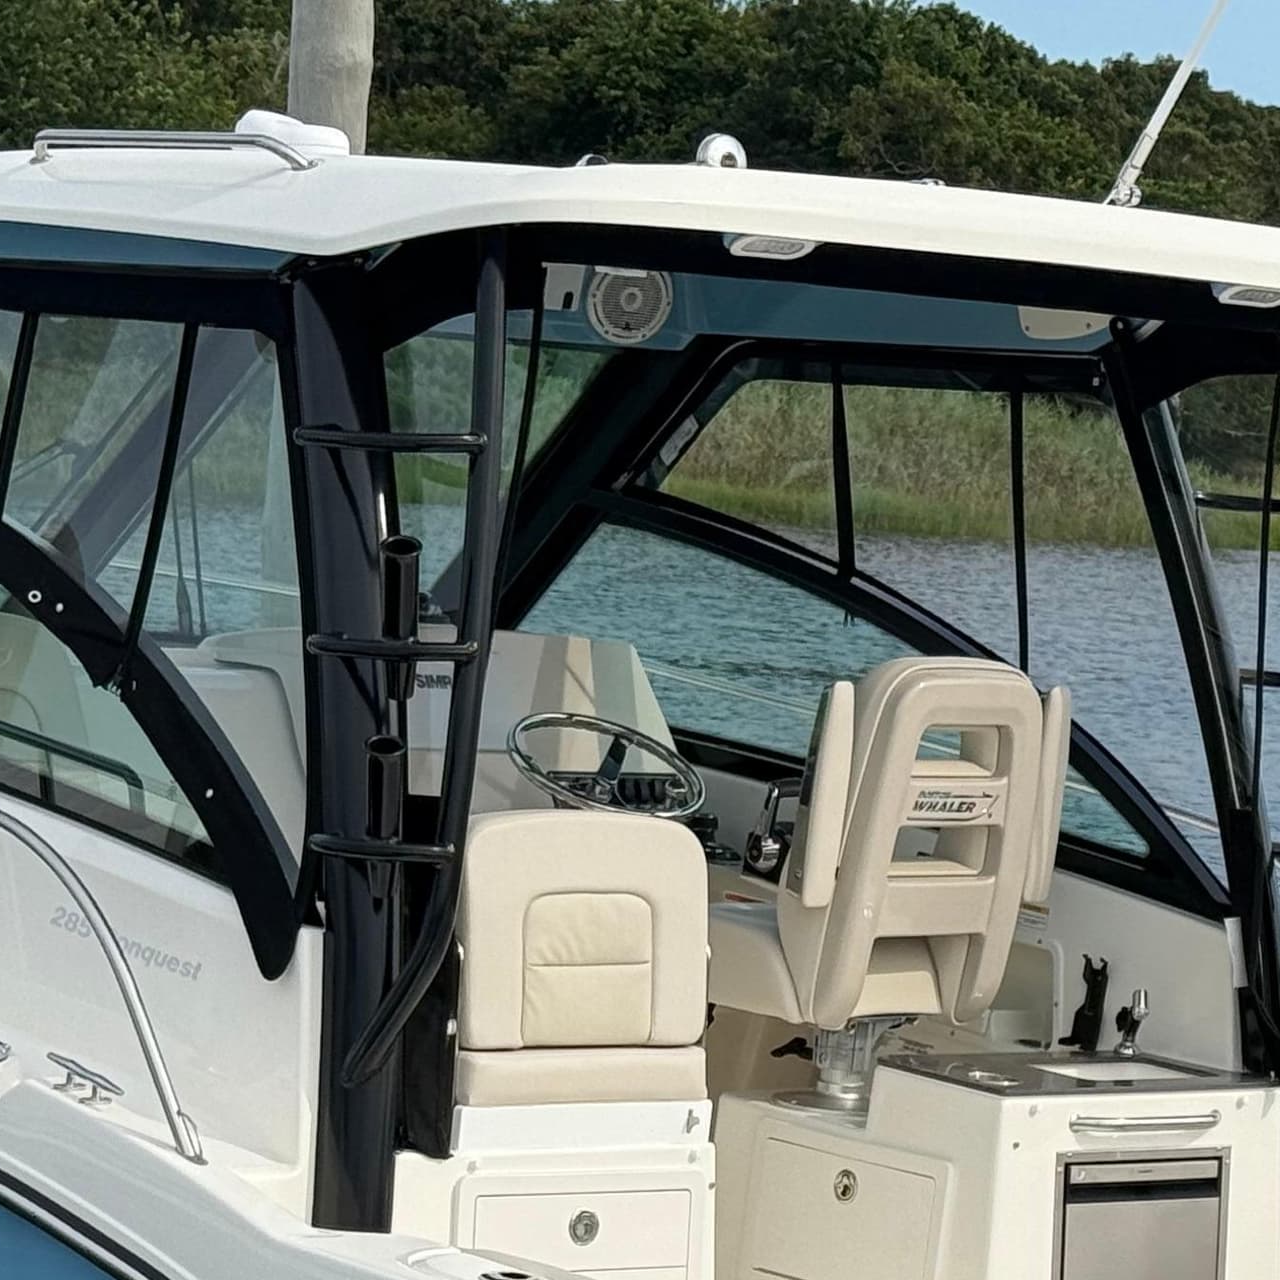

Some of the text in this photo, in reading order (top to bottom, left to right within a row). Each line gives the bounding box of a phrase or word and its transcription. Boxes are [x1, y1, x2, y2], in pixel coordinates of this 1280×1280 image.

[912, 800, 977, 813] WHALER
[49, 906, 203, 981] 285 onquest
